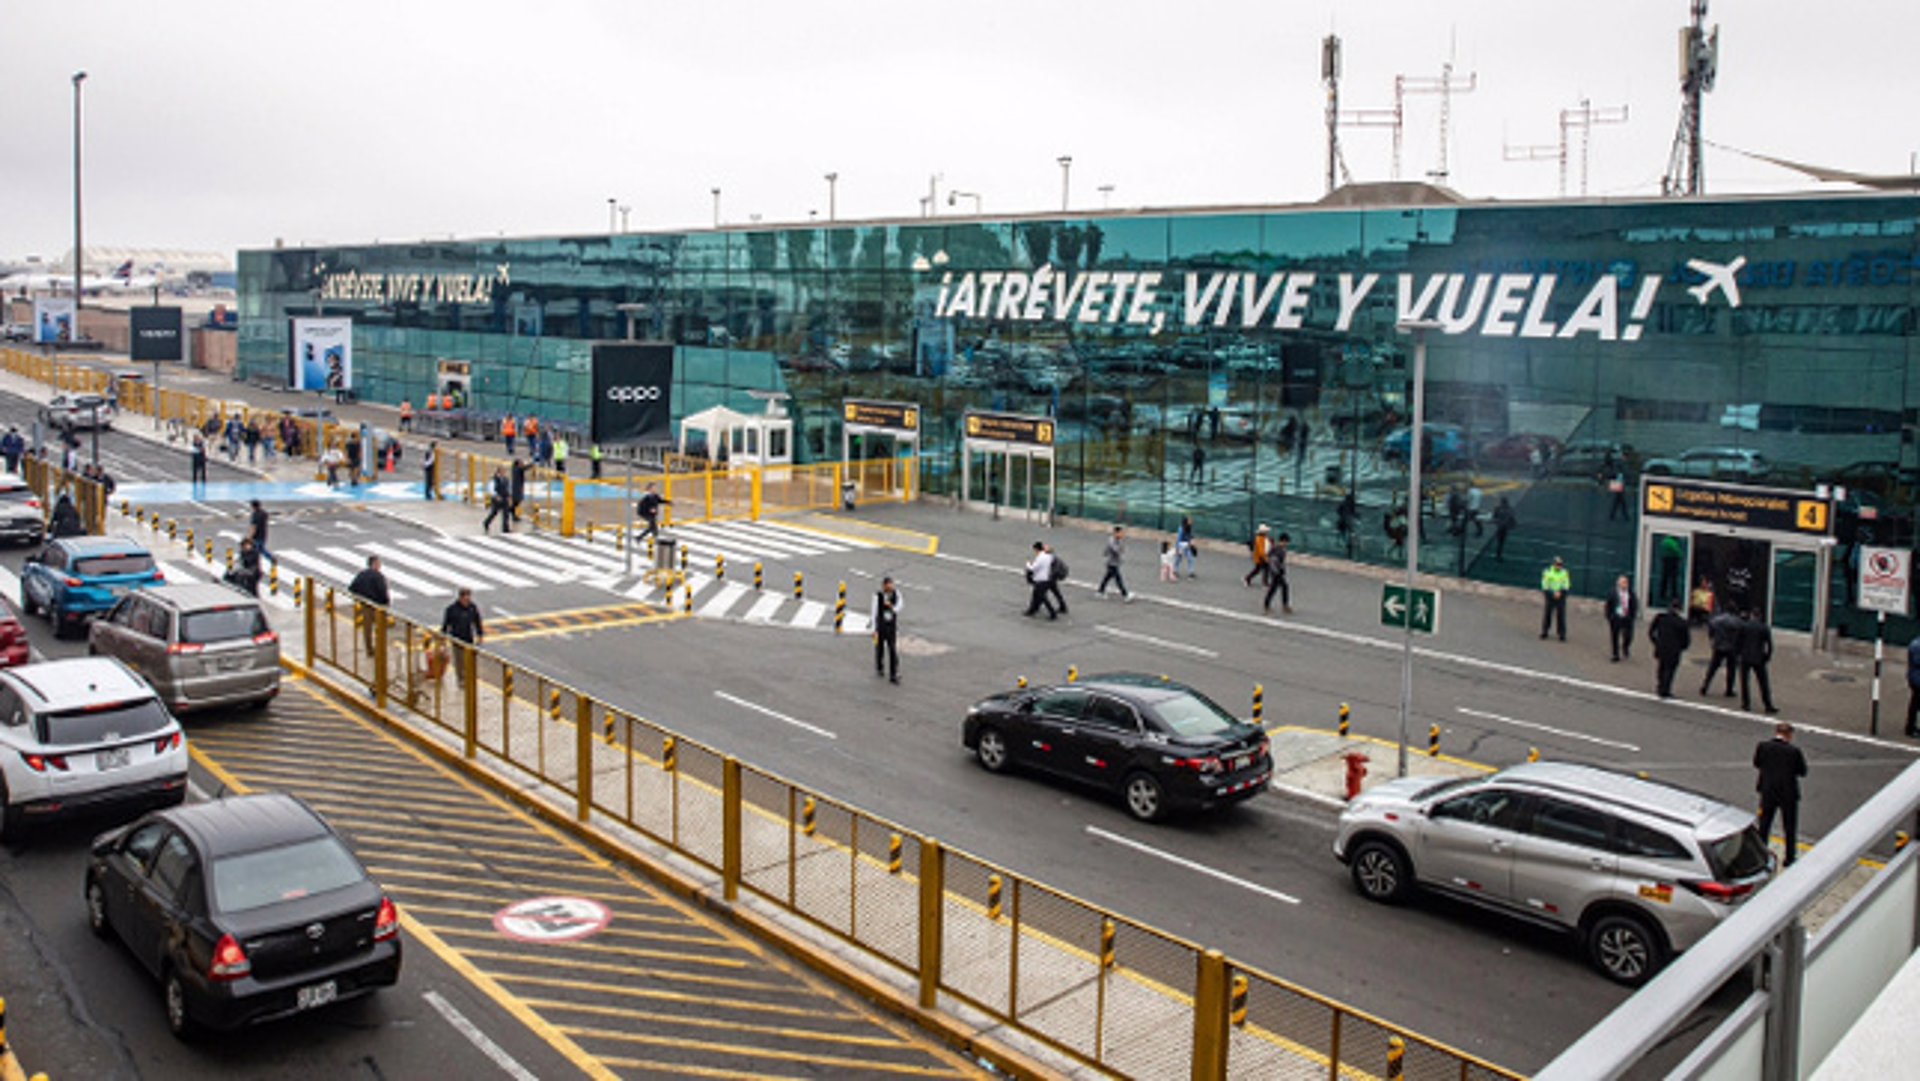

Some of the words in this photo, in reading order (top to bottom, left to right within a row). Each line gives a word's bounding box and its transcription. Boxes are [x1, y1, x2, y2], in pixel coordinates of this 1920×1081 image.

[935, 262, 1166, 335] ¡ATRÉVETE,
[1185, 270, 1316, 330] VIVE
[1334, 273, 1379, 331] Y
[1396, 273, 1662, 341] VUELA!
[607, 386, 661, 403] oppo
[1804, 506, 1817, 525] 4
